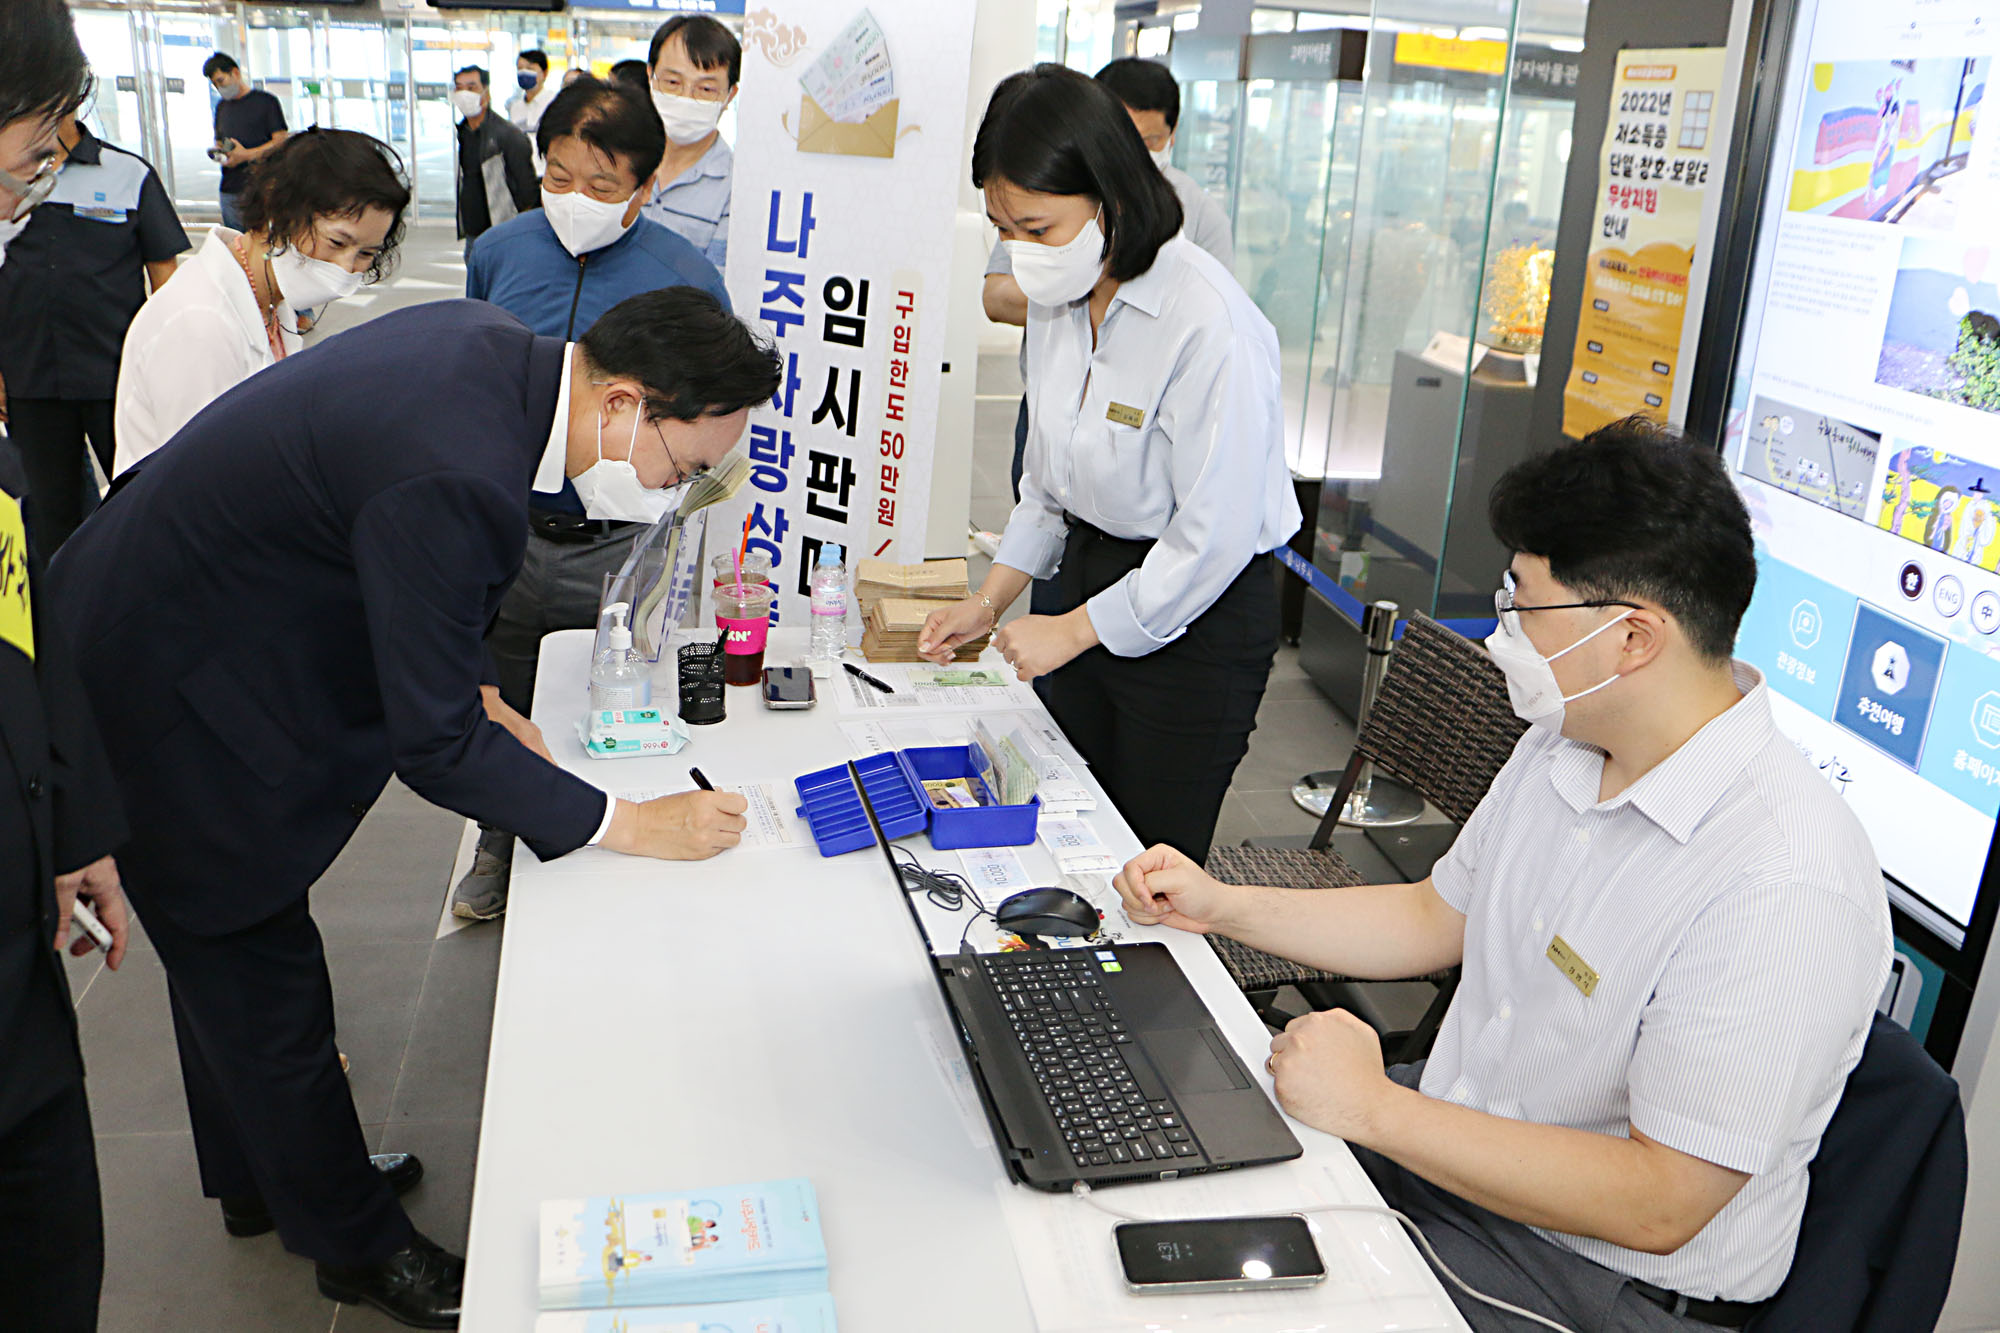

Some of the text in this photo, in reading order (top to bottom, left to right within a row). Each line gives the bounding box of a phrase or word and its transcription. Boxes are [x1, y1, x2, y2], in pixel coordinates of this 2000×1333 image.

[1620, 90, 1673, 117] 2022년
[1607, 183, 1659, 214] 무상지원
[1602, 214, 1630, 239] 안내
[886, 290, 915, 422] 구입한도
[742, 190, 817, 628] 나주사랑상
[877, 429, 905, 528] 50만원
[1904, 571, 1920, 592] 한
[1938, 586, 1960, 605] ENG
[1981, 604, 1993, 621] 中
[1776, 650, 1817, 686] 관광정보
[1856, 695, 1906, 736] 추천여행
[1819, 755, 1854, 796] 나주
